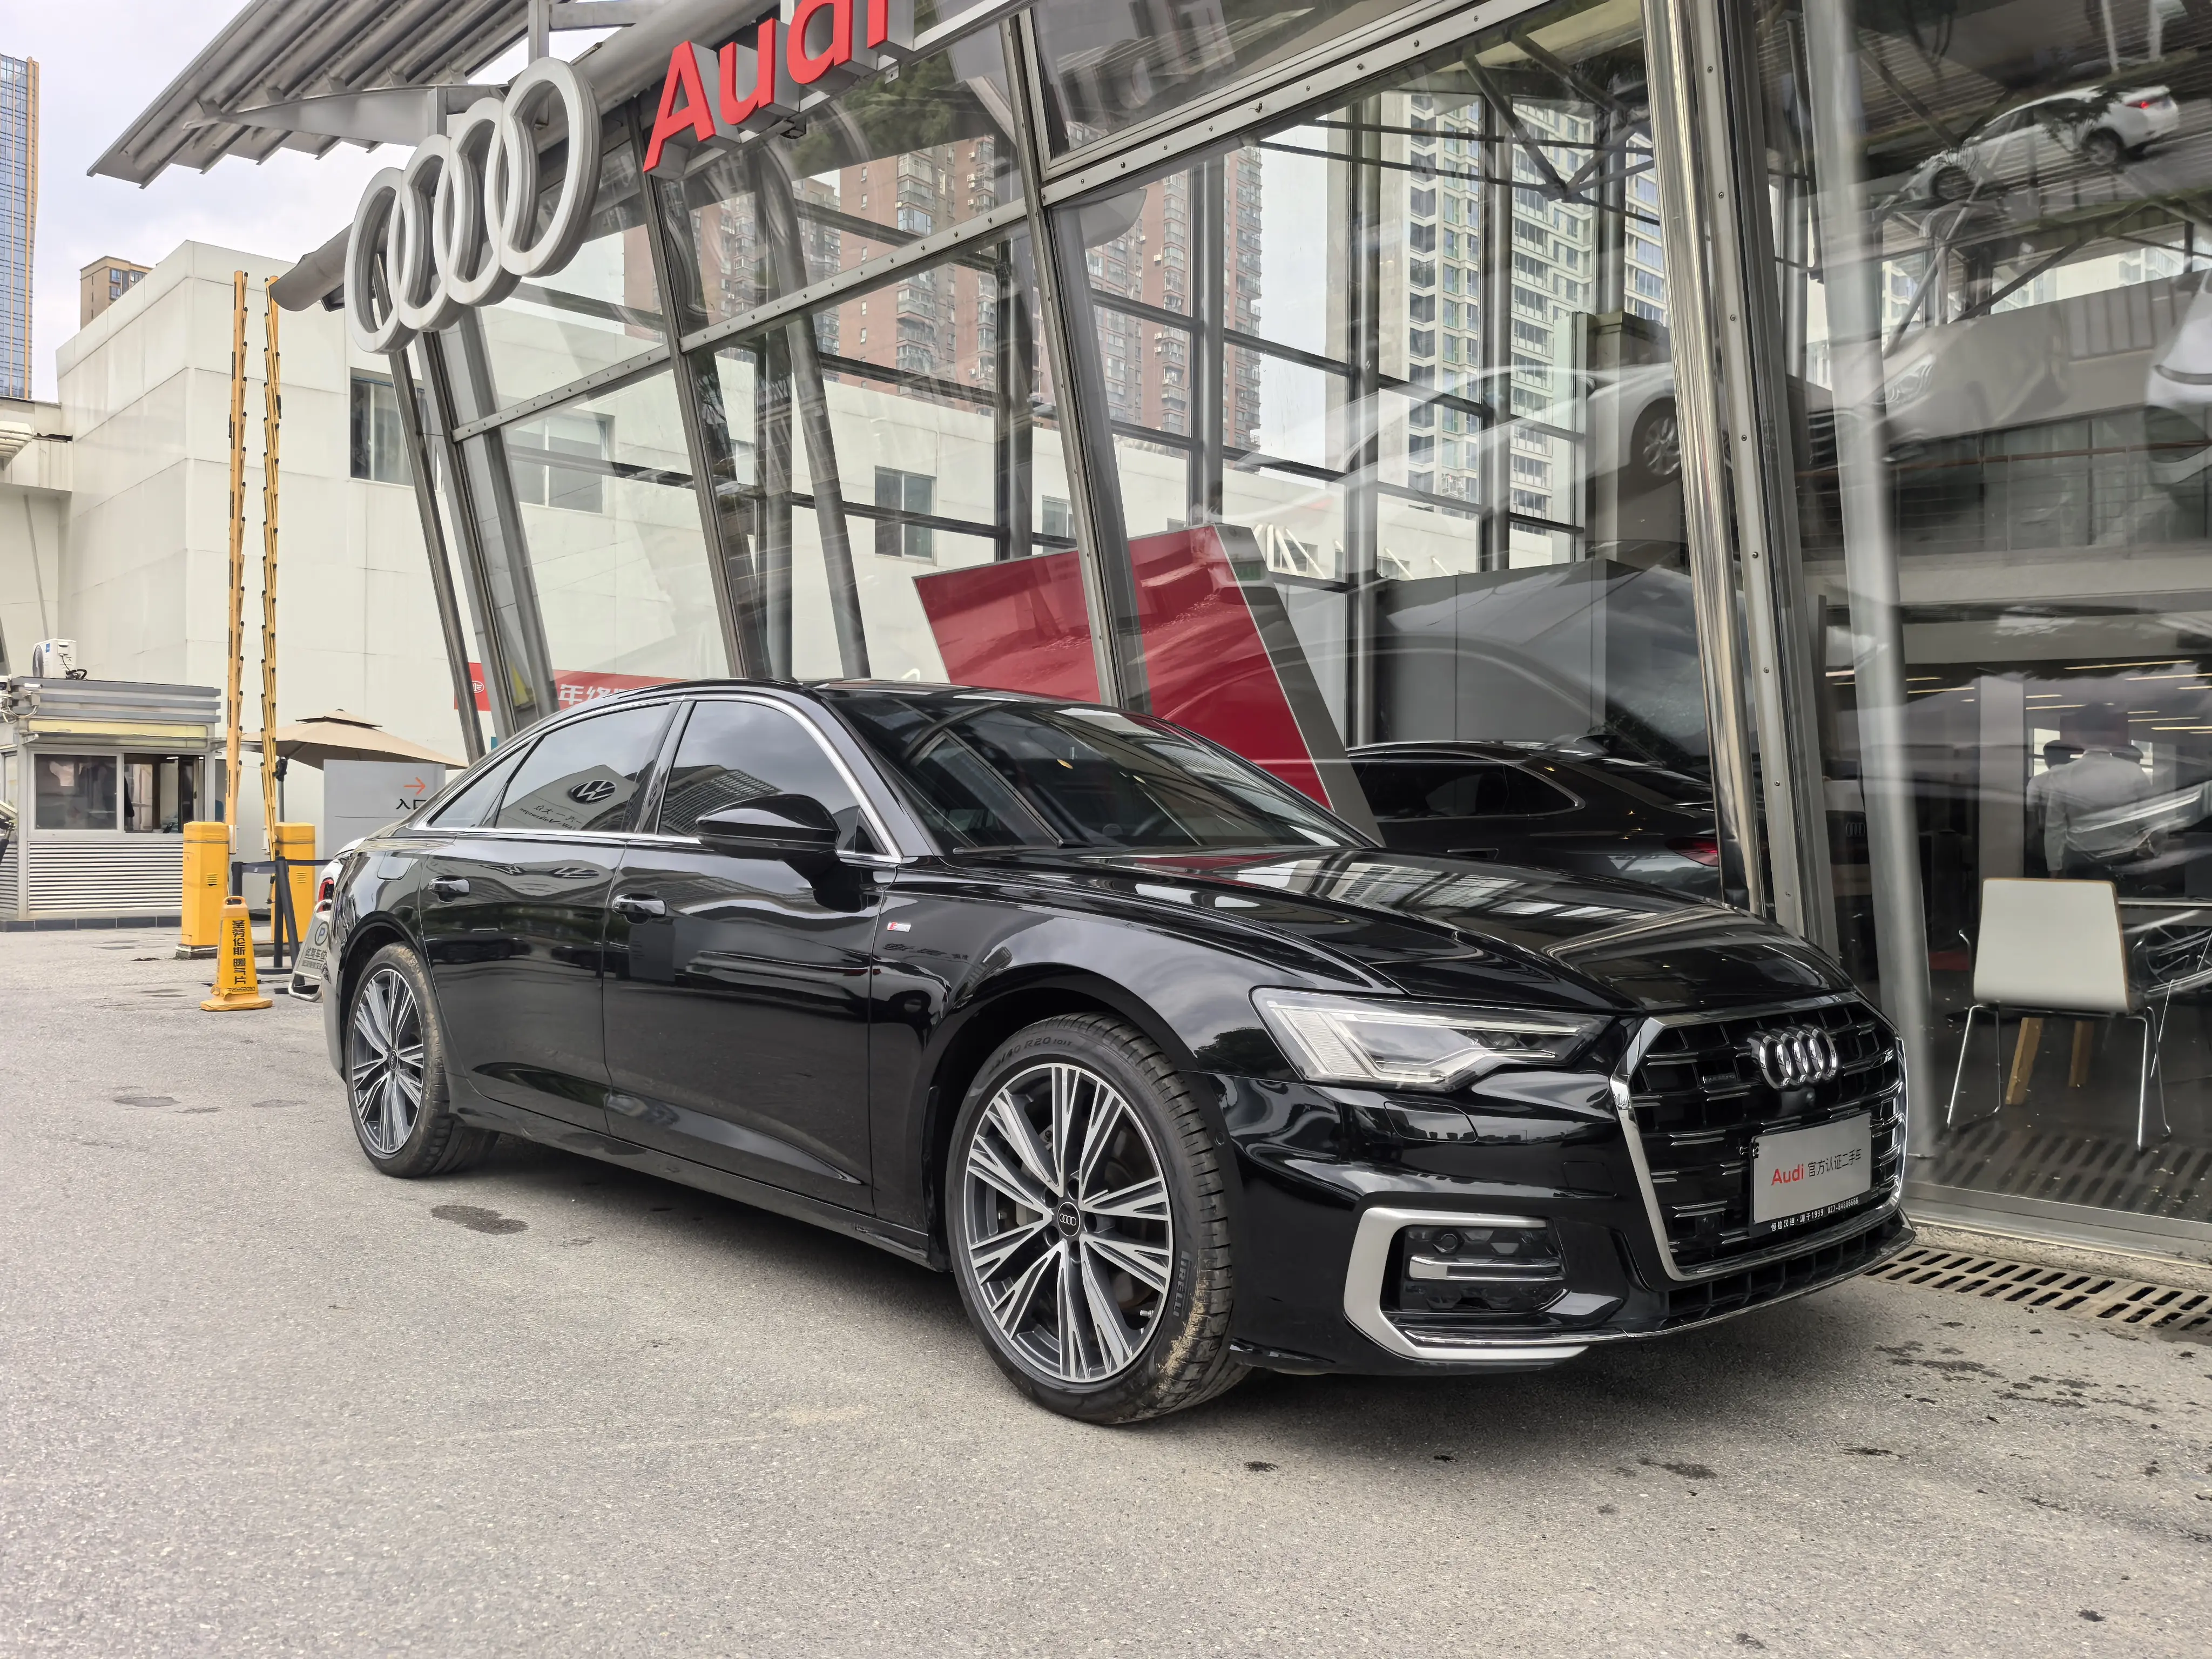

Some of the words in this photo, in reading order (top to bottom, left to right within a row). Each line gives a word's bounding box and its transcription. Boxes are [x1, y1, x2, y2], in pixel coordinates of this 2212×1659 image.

[558, 684, 624, 705] 年终
[395, 798, 427, 810] 入口
[316, 927, 326, 941] P
[1023, 1036, 1051, 1049] R20
[1771, 1163, 1804, 1186] Audi
[1808, 1148, 1862, 1177] 官方认证二手车
